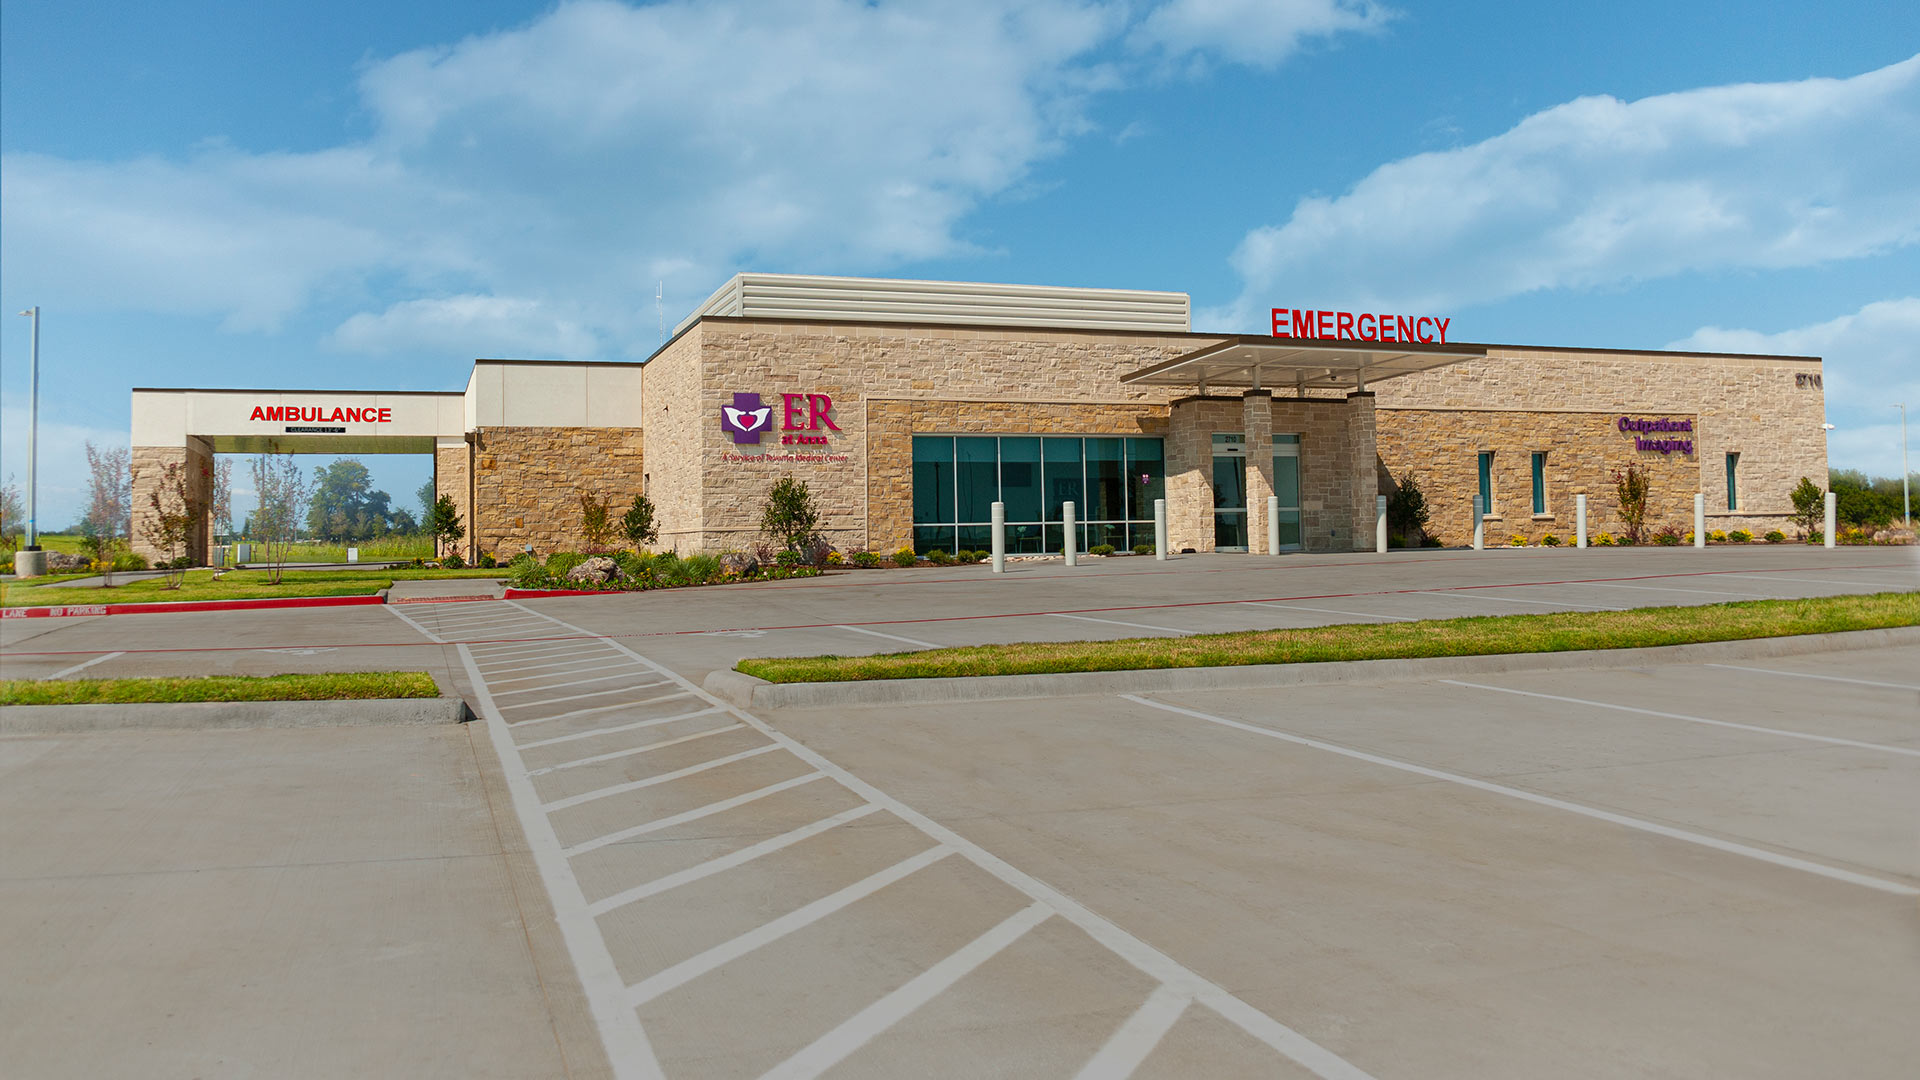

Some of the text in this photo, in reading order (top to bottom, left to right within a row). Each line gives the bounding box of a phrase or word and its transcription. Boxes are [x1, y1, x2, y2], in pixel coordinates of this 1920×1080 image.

[1271, 307, 1450, 345] EMERGENCY
[249, 405, 392, 423] AMBULANCE
[779, 392, 843, 431] ER
[1618, 416, 1693, 435] Outpatient
[781, 433, 828, 445] at Anna
[1635, 435, 1693, 455] Imaging
[729, 453, 755, 462] Service
[795, 453, 823, 462] Medical
[824, 453, 848, 462] Center
[2, 605, 107, 618] LANE NO PARKING
